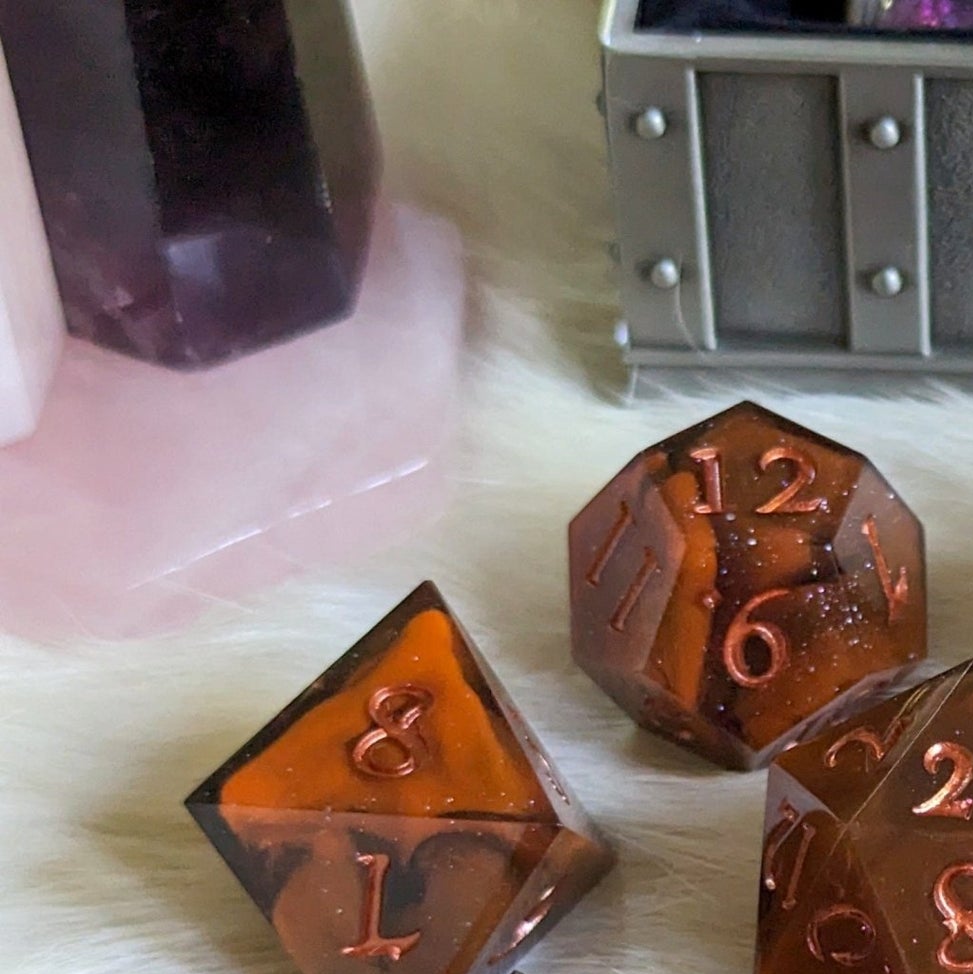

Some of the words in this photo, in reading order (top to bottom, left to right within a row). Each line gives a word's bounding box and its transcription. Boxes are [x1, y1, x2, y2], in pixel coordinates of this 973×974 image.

[689, 447, 828, 514] 12
[724, 588, 787, 688] 6
[352, 683, 434, 778] 8
[341, 853, 422, 961] 1
